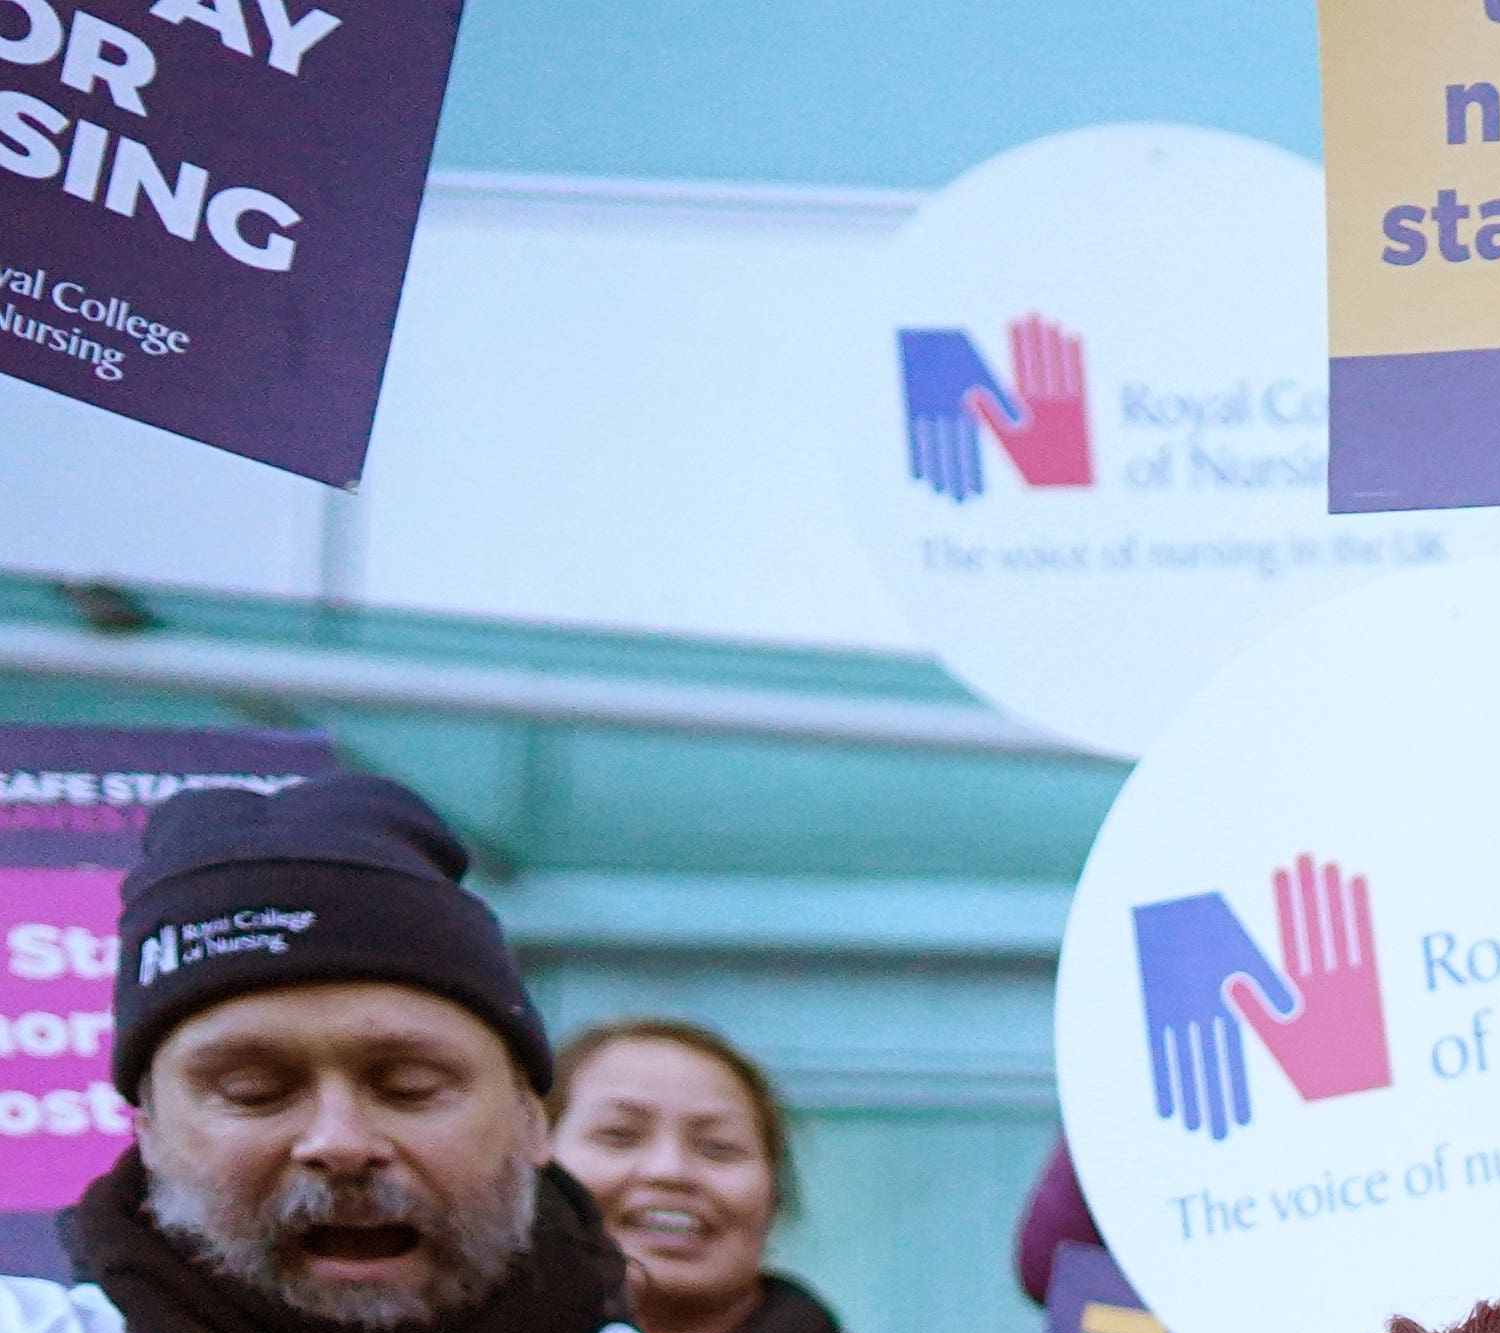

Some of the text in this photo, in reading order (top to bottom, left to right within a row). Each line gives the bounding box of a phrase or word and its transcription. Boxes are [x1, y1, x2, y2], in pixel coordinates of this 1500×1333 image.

[52, 281, 191, 355] College
[1431, 1008, 1493, 1080] of
[1167, 1189, 1257, 1241] The
[1271, 1170, 1390, 1222] voice
[1404, 1142, 1452, 1200] of
